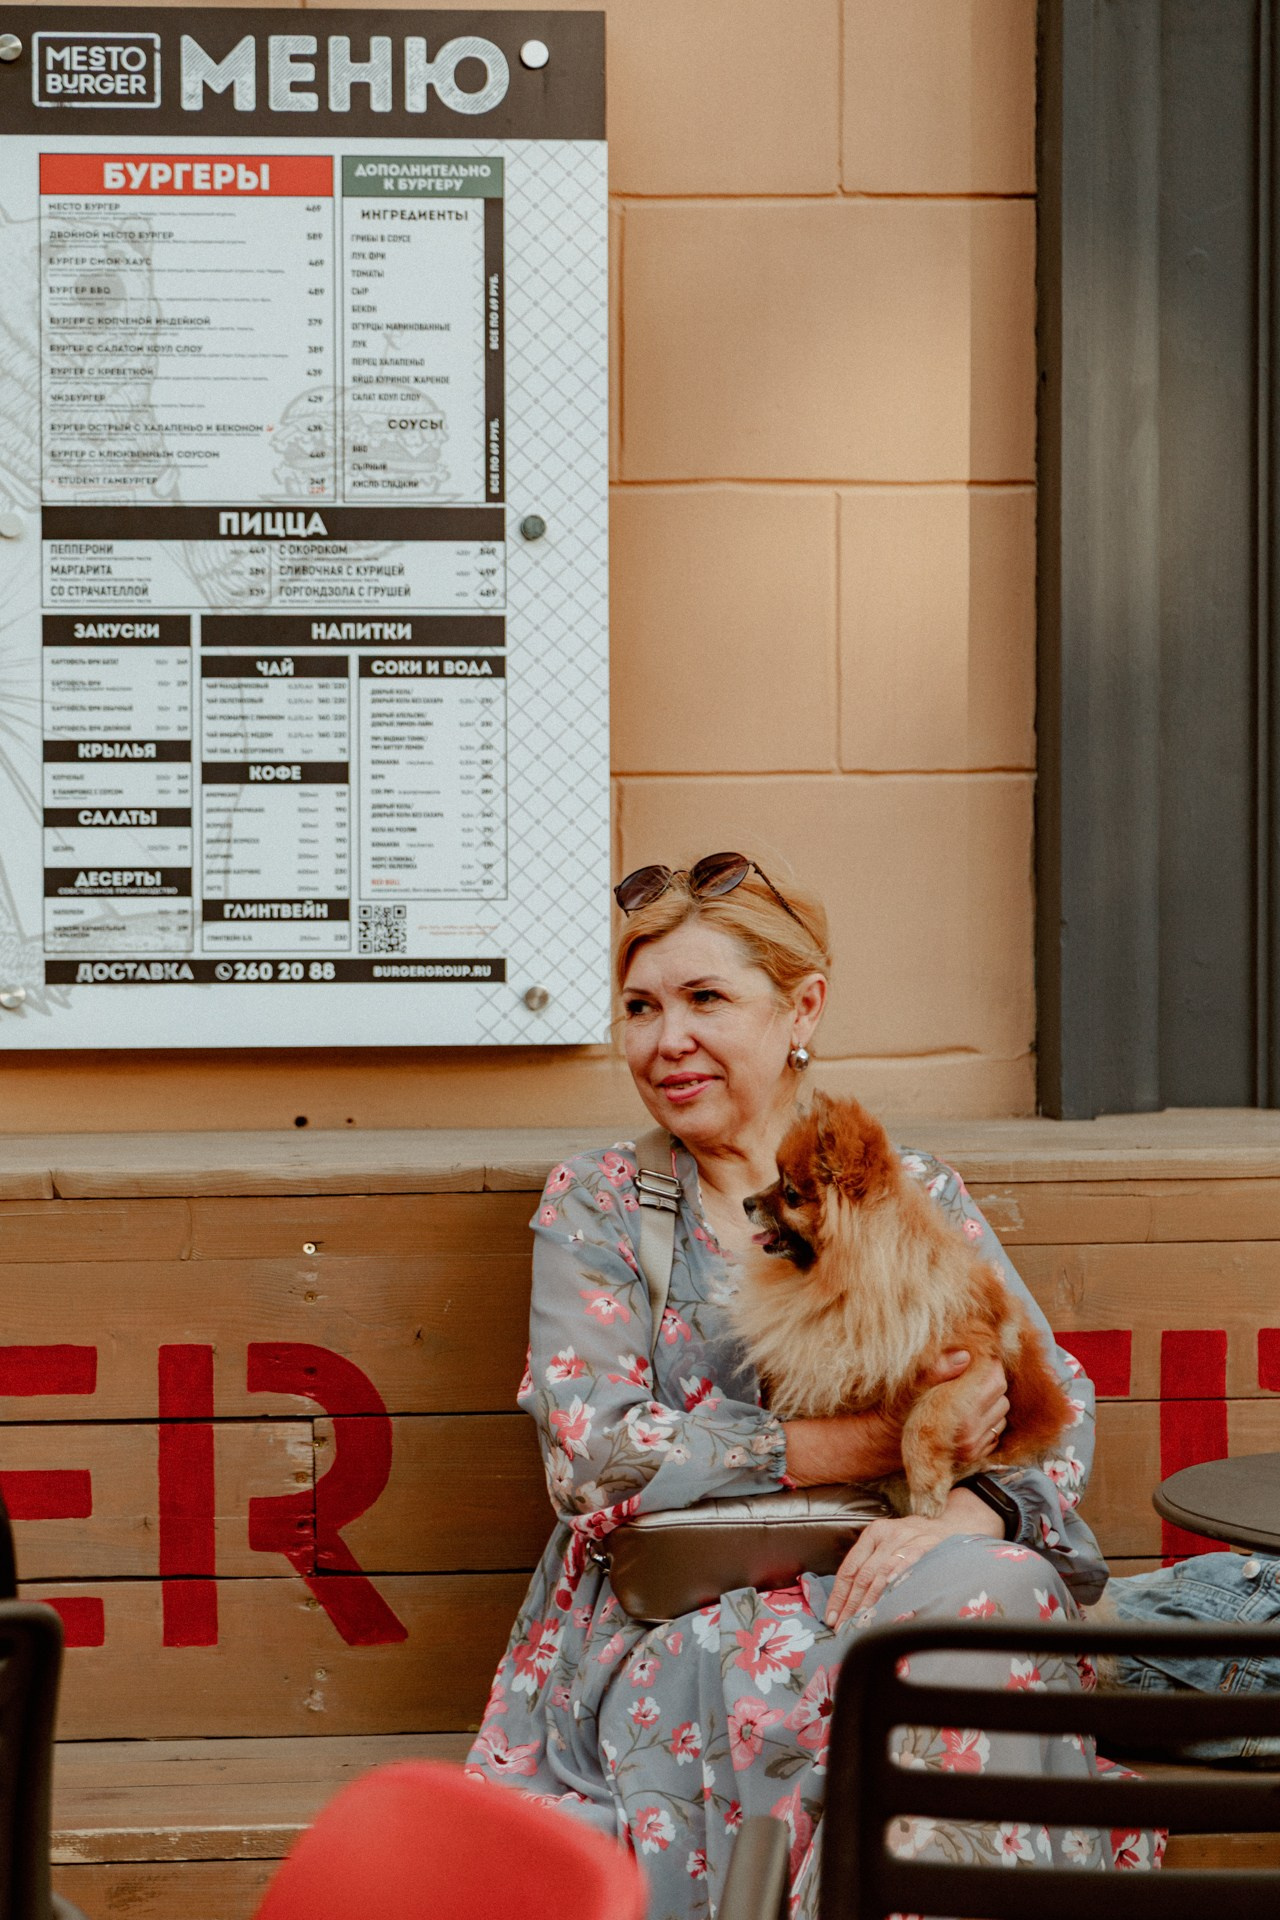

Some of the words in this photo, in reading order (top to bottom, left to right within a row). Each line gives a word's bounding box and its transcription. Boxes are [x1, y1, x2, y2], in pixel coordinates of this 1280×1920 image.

[45, 46, 147, 71] MESTO
[180, 35, 510, 115] МЕНЮ
[45, 72, 147, 95] BURGER
[103, 162, 270, 191] БУРГЕРЫ
[354, 163, 491, 178] ДОПОЛНИТЕЛЬНО
[383, 178, 394, 191] К
[397, 178, 464, 191] БУРГЕРУ
[48, 203, 82, 211] МЕСТО
[84, 203, 121, 211] БУРГЕР
[361, 210, 468, 221] ИНГРЕДИЕНТЫ
[49, 230, 100, 240] ДВОЙНОЙ
[102, 232, 136, 240] МЕСТО
[138, 232, 175, 240] БУРГЕР
[49, 257, 87, 266] БУРГЕР
[49, 287, 87, 295] БУРГЕР
[49, 317, 86, 326] БУРГЕР
[87, 317, 95, 326] С
[97, 316, 152, 326] КОПЧЕНОЙ
[155, 316, 211, 326] ИНДЕЙКОЙ
[50, 345, 85, 353] БУРГЕР
[86, 345, 94, 353] С
[96, 345, 144, 353] САЛАТОМ
[147, 345, 173, 353] КОУЛ
[175, 345, 203, 353] СЛОУ
[50, 394, 106, 402] ЧИЗБУРГЕР
[388, 419, 443, 430] СОУСЫ
[50, 451, 87, 459] БУРГЕР
[88, 451, 95, 459] С
[98, 451, 174, 459] КЛЮКВЕННЫМ
[176, 451, 220, 459] СОУСОМ
[218, 511, 329, 538] ПИЦЦА
[50, 544, 114, 555] ПЕППЕРОНИ
[279, 545, 286, 555] С
[288, 545, 348, 555] ОКОРОКОМ
[50, 565, 113, 575] МАРГАРИТА
[279, 565, 343, 576] СЛИВОЧНАЯ
[346, 565, 353, 576] С
[356, 564, 405, 576] КУРИЦЕЙ
[50, 586, 65, 596] СО
[67, 584, 149, 596] СТРАЧАТЕЛЛОЙ
[279, 586, 356, 597] ГОРГОНДЗОЛА
[358, 586, 365, 597] С
[367, 585, 411, 597] ГРУШЕЙ
[73, 623, 160, 639] ЗАКУСКИ
[311, 622, 412, 640] НАПИТКИ
[255, 658, 295, 676] ЧАЙ
[371, 660, 422, 675] СОКИ
[426, 660, 440, 675] И
[443, 660, 493, 675] ВОДА
[78, 743, 157, 758] КРЫЛЬЯ
[249, 765, 302, 781] КОФЕ
[78, 810, 158, 826] САЛАТЫ
[74, 871, 162, 887] ДЕСЕРТЫ
[223, 900, 328, 919] ГЛИНТВЕЙН
[76, 962, 194, 983] ДОСТАВКА
[233, 962, 274, 981] 260
[277, 962, 304, 981] 20
[308, 962, 336, 981] 88
[372, 965, 491, 978] BURGERGROUP.RU
